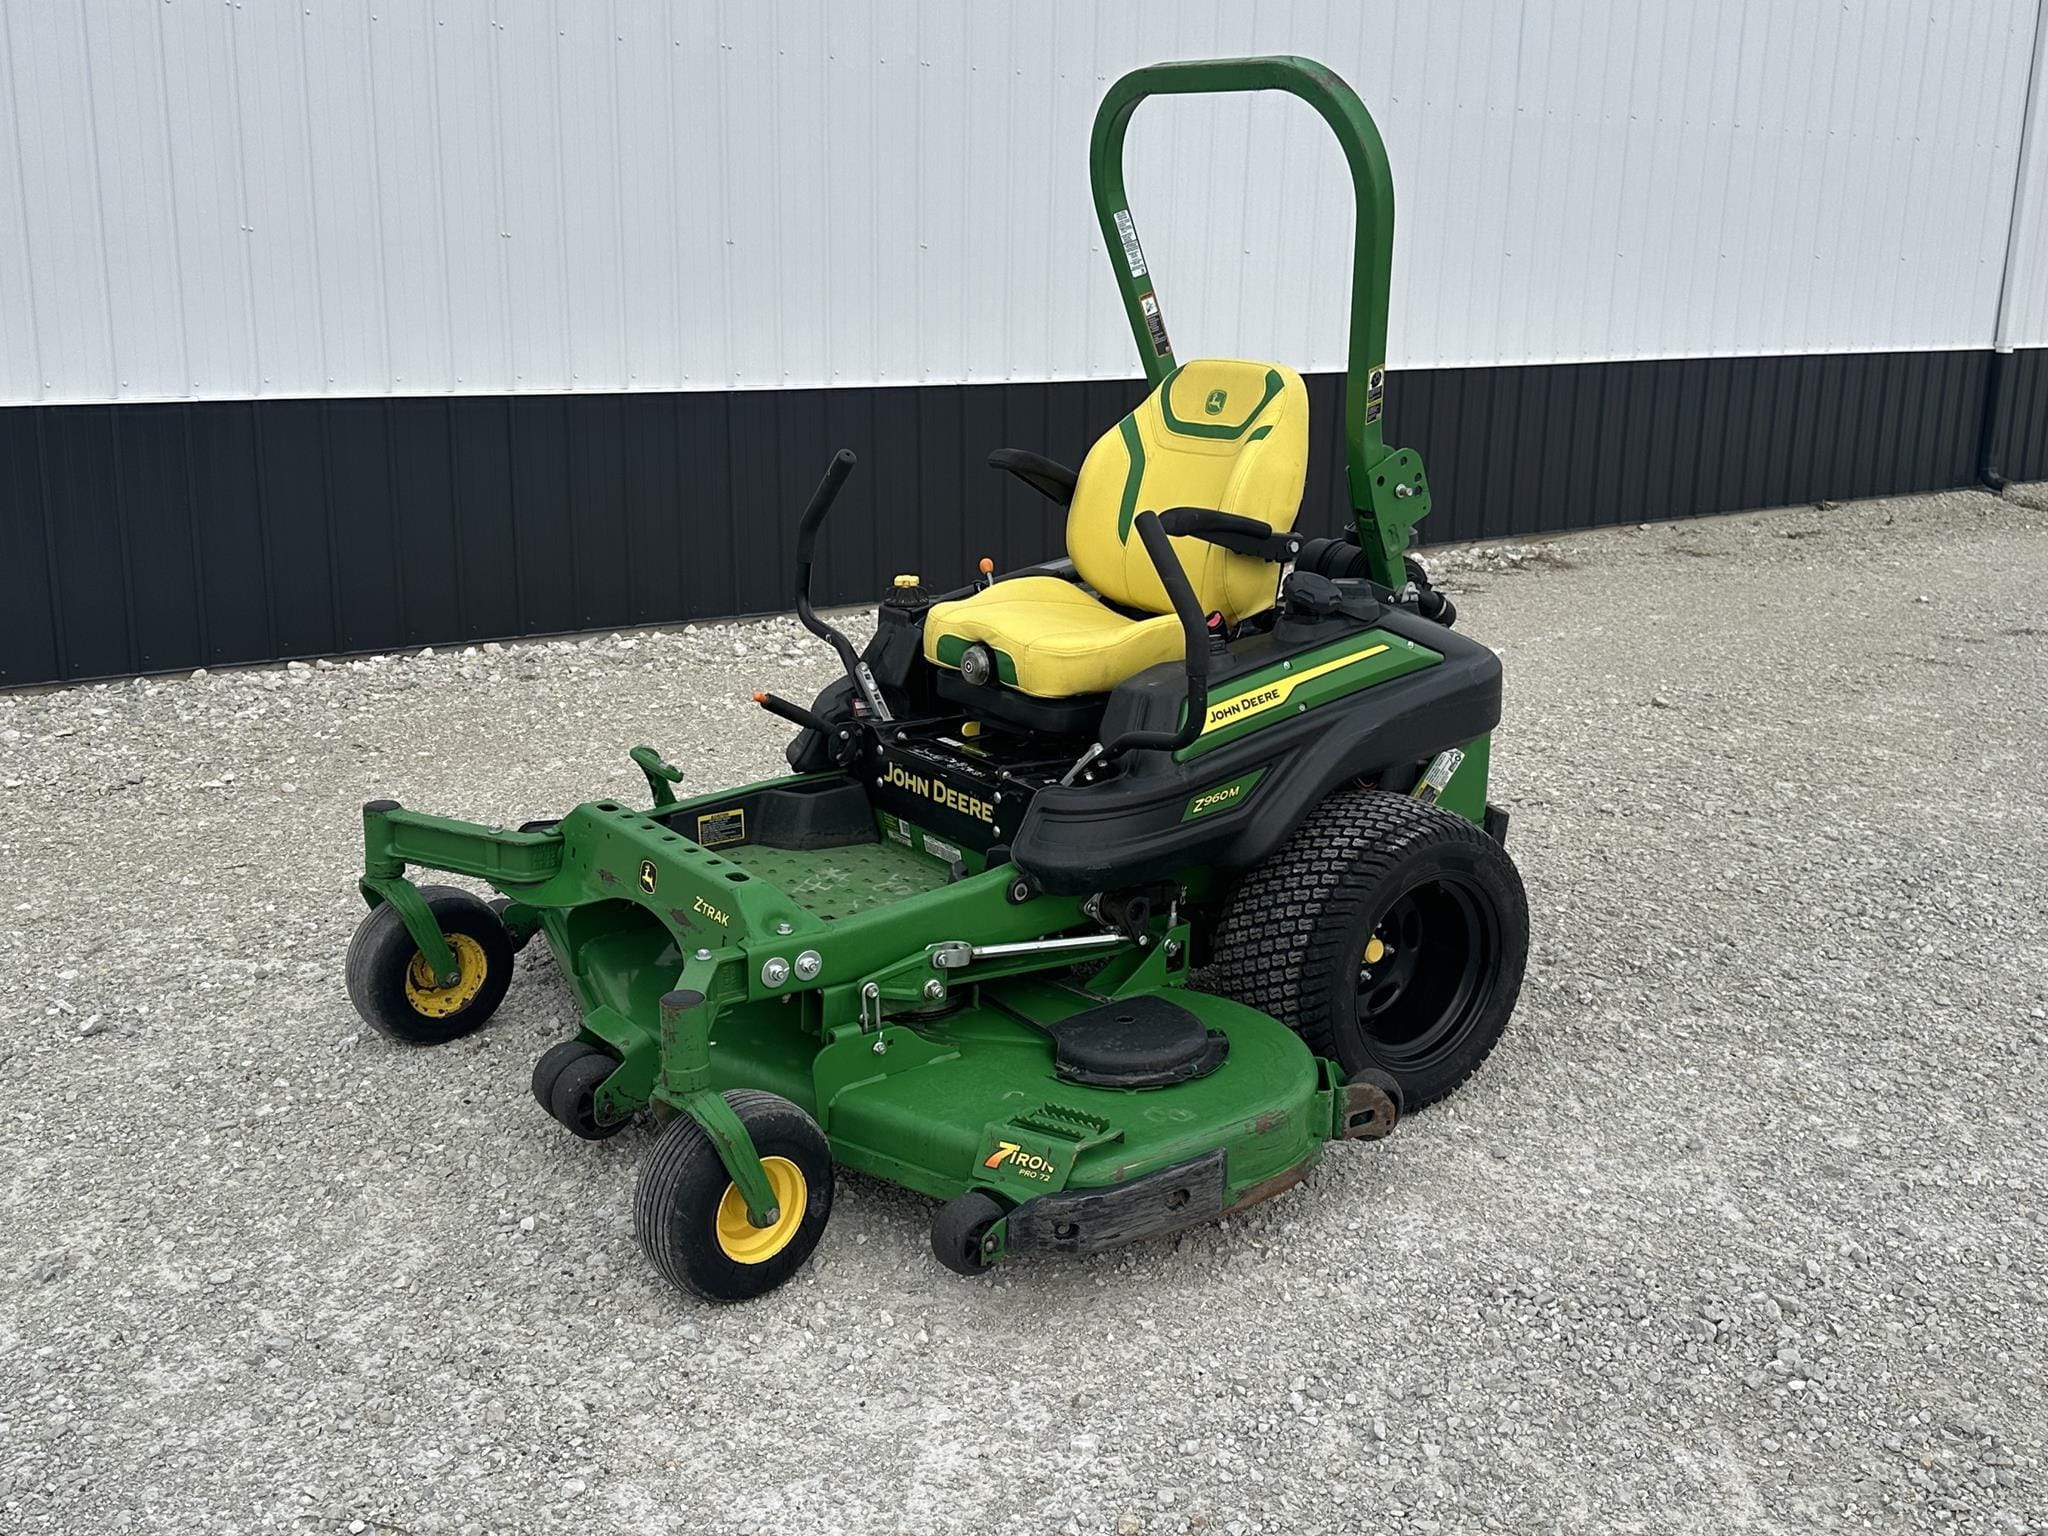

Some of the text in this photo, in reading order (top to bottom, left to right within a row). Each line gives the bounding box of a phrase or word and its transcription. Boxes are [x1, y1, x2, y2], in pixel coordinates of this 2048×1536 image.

[1210, 689, 1280, 723] JOHN DEERE
[883, 761, 929, 798] JOHN
[933, 779, 994, 824] DEERE
[1192, 785, 1240, 813] Z960M
[693, 895, 730, 927] ZTRAK
[1018, 1168, 1051, 1182] PRO 72
